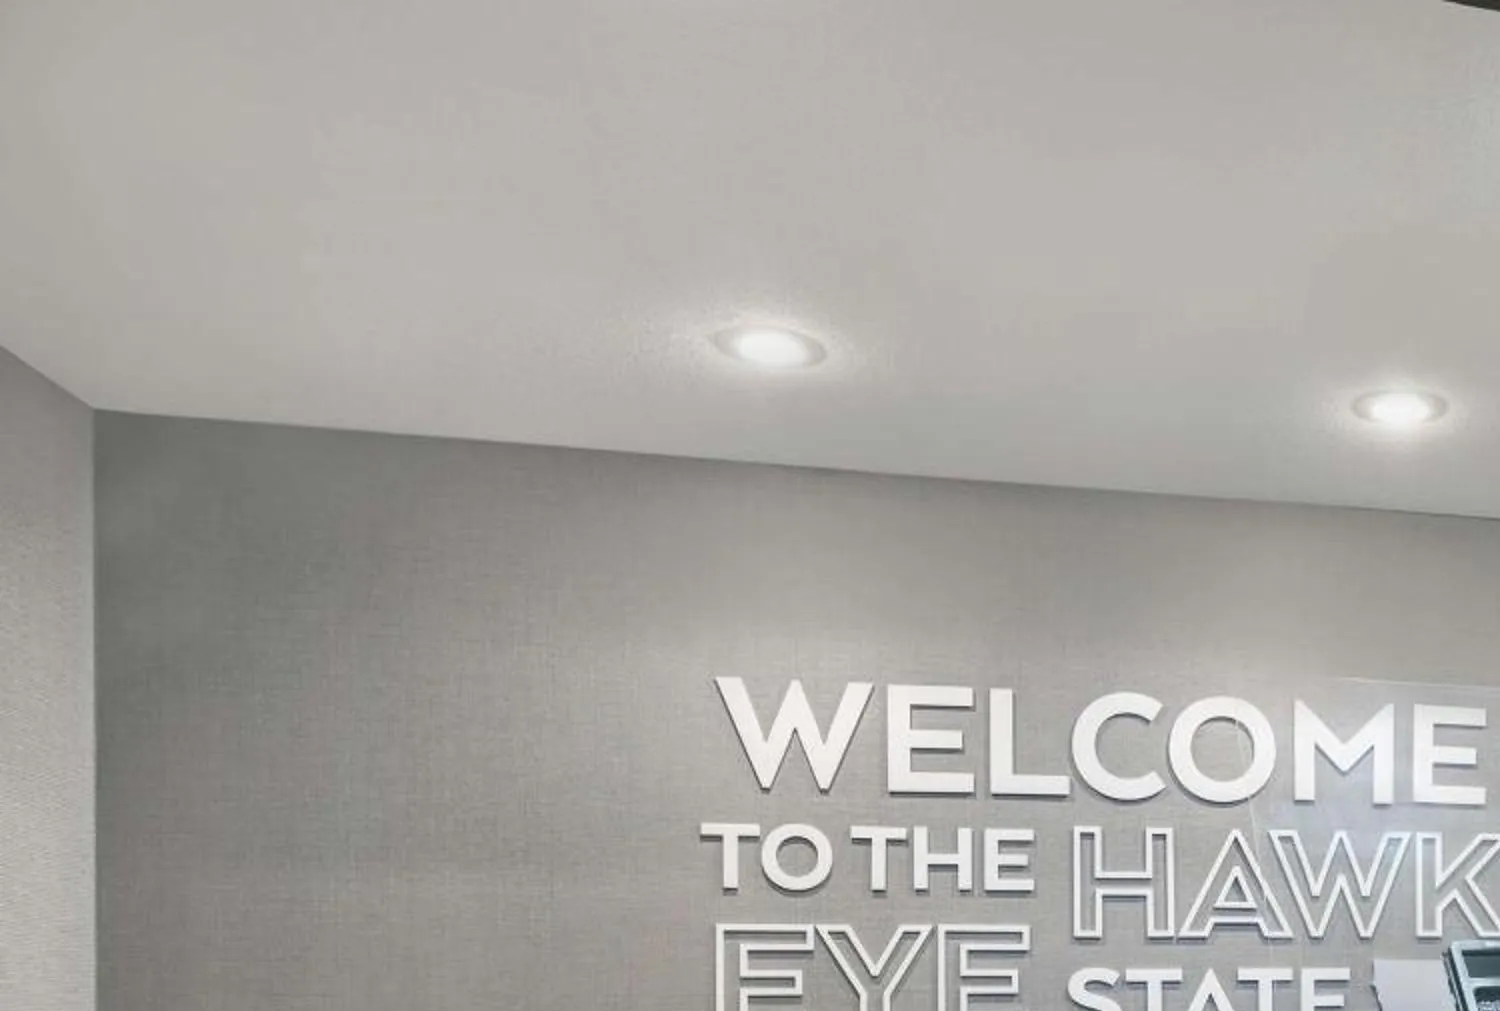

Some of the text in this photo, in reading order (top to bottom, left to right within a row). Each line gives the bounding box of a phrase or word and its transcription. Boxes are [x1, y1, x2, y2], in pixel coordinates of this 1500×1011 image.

[715, 676, 1488, 806] WELCOME
[700, 822, 834, 892] TO
[851, 824, 1036, 893] THE
